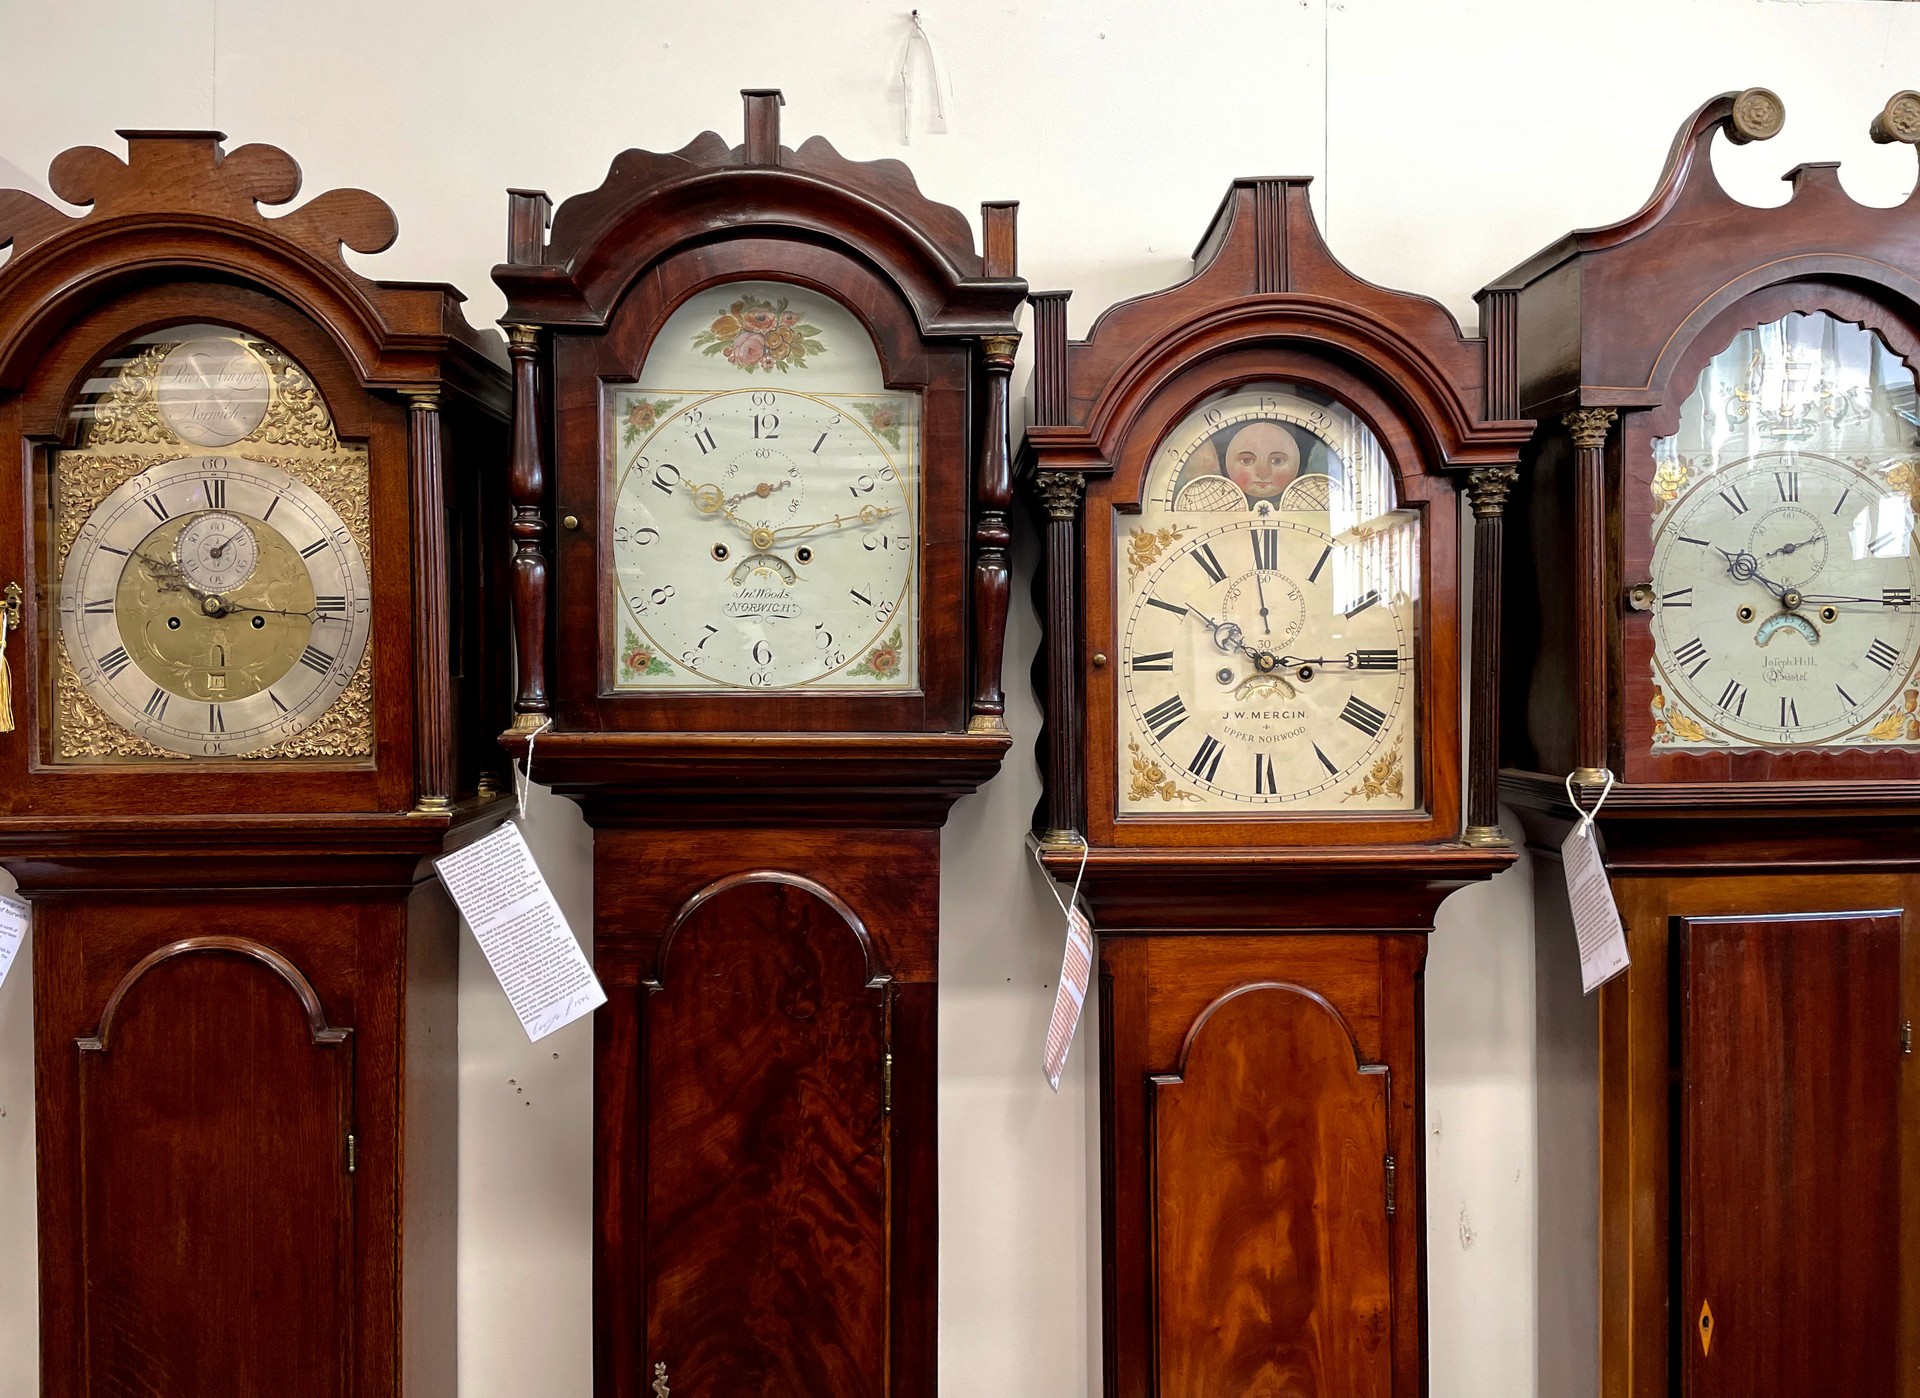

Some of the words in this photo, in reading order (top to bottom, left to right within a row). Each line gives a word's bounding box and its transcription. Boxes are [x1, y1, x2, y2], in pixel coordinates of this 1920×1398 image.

[751, 391, 776, 406] 60
[1259, 396, 1277, 412] 15
[683, 407, 703, 428] 55
[749, 413, 780, 439] 12
[828, 413, 841, 426] 5
[1203, 408, 1222, 427] 10
[1308, 410, 1333, 430] 20
[690, 427, 717, 456] 11
[809, 429, 828, 456] 1
[1167, 448, 1180, 460] 5
[202, 459, 228, 471] 60
[631, 456, 650, 479] 50
[878, 464, 895, 482] 10
[132, 472, 152, 491] 55
[284, 477, 295, 490] 5
[650, 463, 681, 497] 10
[849, 475, 876, 498] 2
[78, 523, 98, 542] 50
[332, 525, 351, 545] 10
[614, 526, 629, 550] 45
[634, 527, 660, 546] 9
[862, 532, 888, 551] 3
[896, 534, 910, 551] 15
[758, 559, 766, 567] 6
[776, 562, 783, 571] 9
[651, 584, 676, 605] 8
[849, 582, 872, 607] 4
[1229, 588, 1241, 602] 50
[1287, 590, 1298, 602] 10
[355, 598, 370, 613] 15
[629, 596, 649, 617] 40
[874, 600, 894, 623] 20
[697, 624, 719, 649] 7
[814, 622, 833, 650] 5
[1285, 621, 1298, 635] 20
[752, 639, 773, 665] 6
[1257, 640, 1271, 649] 30
[680, 650, 705, 671] 35
[824, 650, 846, 670] 25
[334, 664, 354, 687] 20
[749, 671, 774, 687] 30
[280, 717, 303, 737] 25
[1223, 726, 1254, 742] UPPER
[1258, 726, 1306, 743] NORWOOD
[203, 741, 227, 755] 30
[6, 908, 27, 921] Norwich
